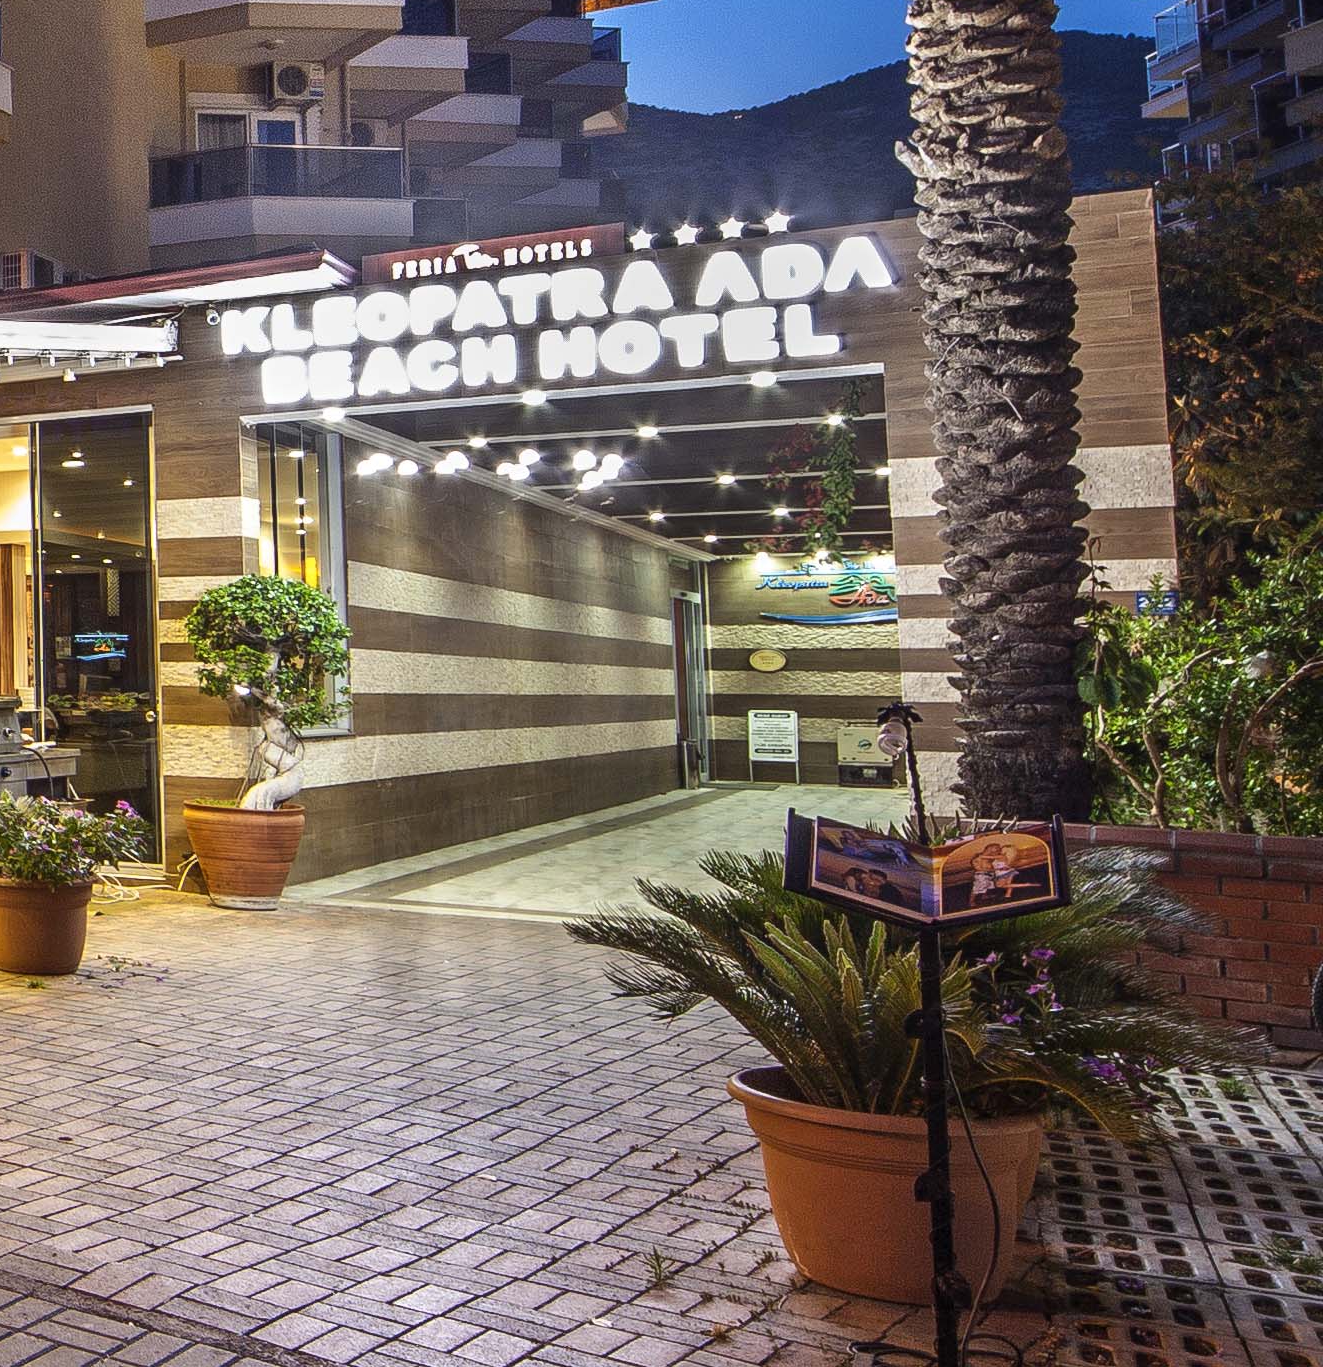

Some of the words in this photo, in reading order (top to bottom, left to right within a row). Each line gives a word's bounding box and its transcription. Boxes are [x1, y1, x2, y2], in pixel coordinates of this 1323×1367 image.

[503, 238, 592, 266] HOTELS
[221, 259, 674, 355] KLEOPATRA
[695, 236, 893, 306] ADA
[261, 333, 517, 405] BEACH
[539, 303, 841, 379] HOTEL
[756, 576, 829, 592] Kleopatra
